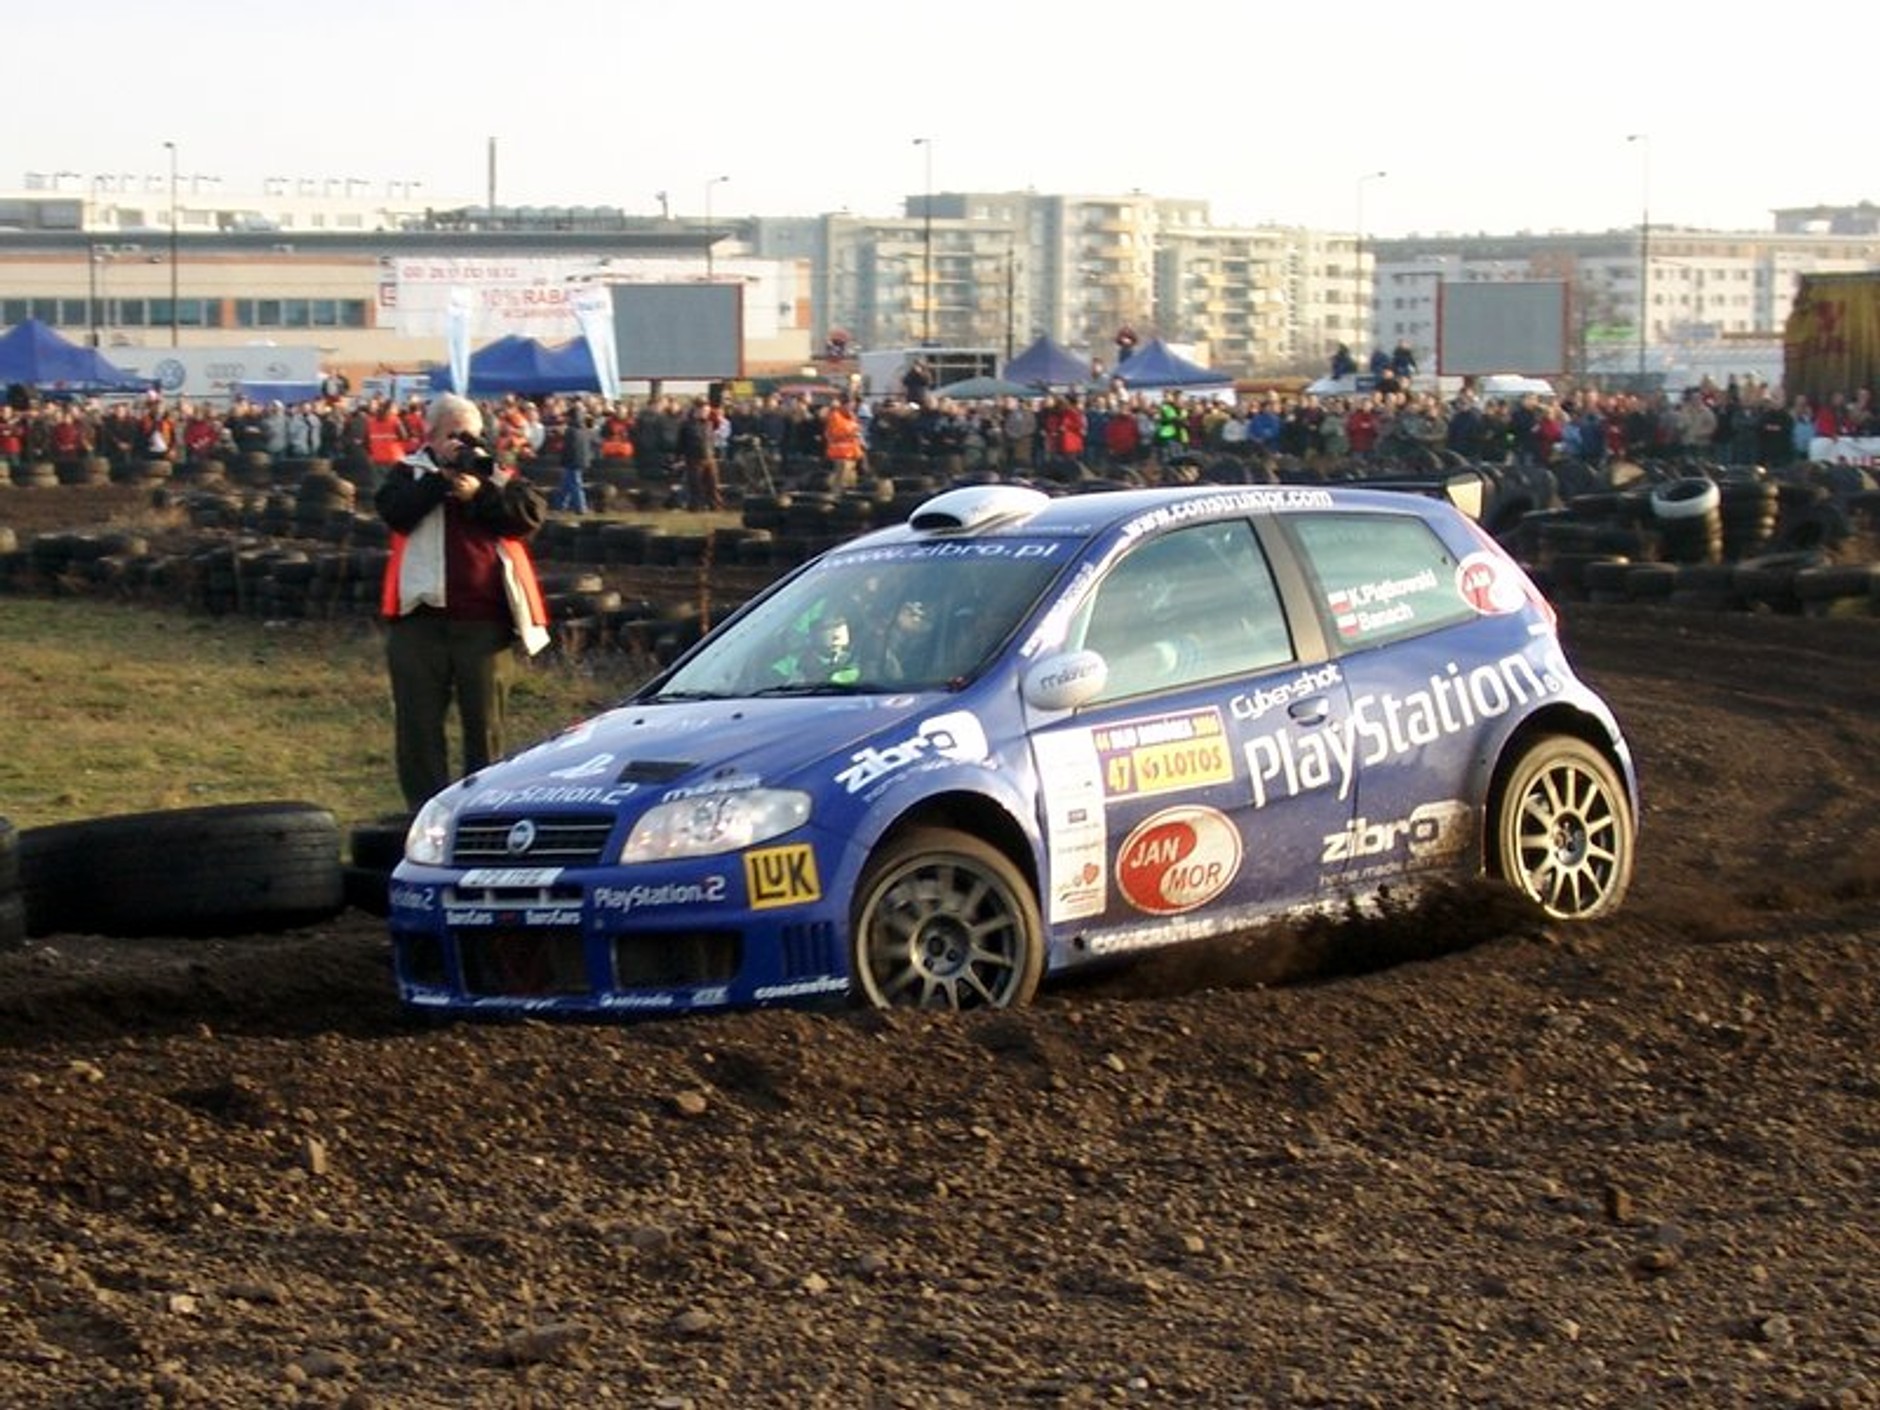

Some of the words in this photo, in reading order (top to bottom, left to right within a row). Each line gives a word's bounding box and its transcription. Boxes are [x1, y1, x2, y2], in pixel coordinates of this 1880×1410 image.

[833, 710, 988, 794] zibro
[1162, 745, 1223, 779] LOTOS
[1322, 799, 1470, 864] zibro
[1130, 837, 1180, 869] JAN
[1168, 862, 1222, 893] MOR
